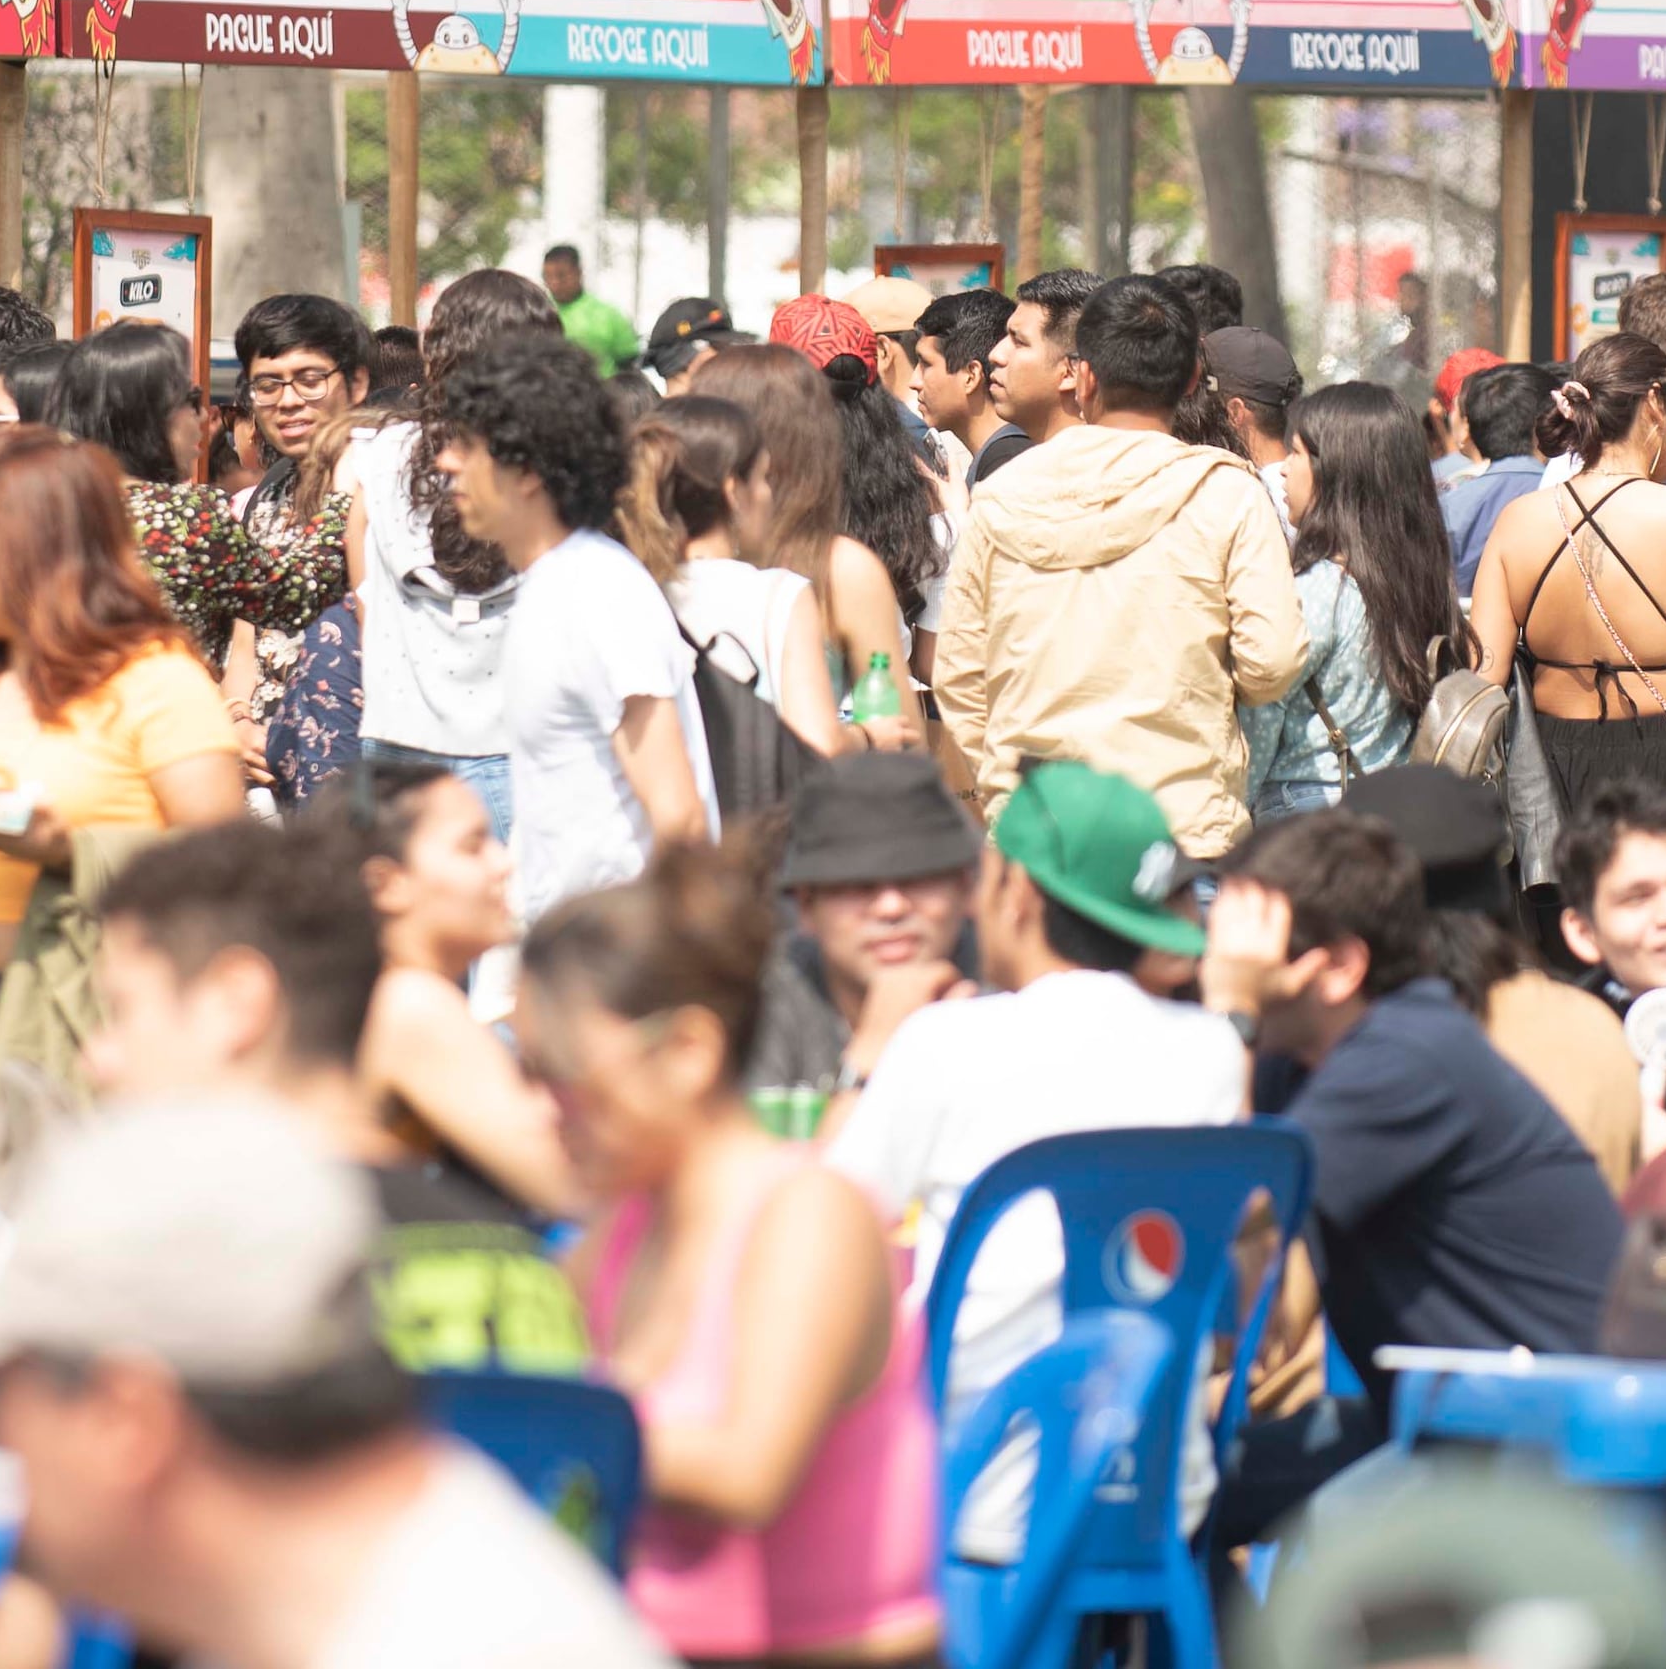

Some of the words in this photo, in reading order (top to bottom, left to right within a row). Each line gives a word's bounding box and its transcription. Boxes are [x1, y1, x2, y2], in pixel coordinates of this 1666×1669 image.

[205, 12, 273, 53] PAGUE
[279, 9, 333, 61] AQUÍ
[567, 23, 647, 64] RECOGE
[967, 28, 1030, 68] PAGUE
[1033, 25, 1083, 72] AQUÍ
[1290, 31, 1364, 71] RECOGE
[129, 280, 153, 302] KILO
